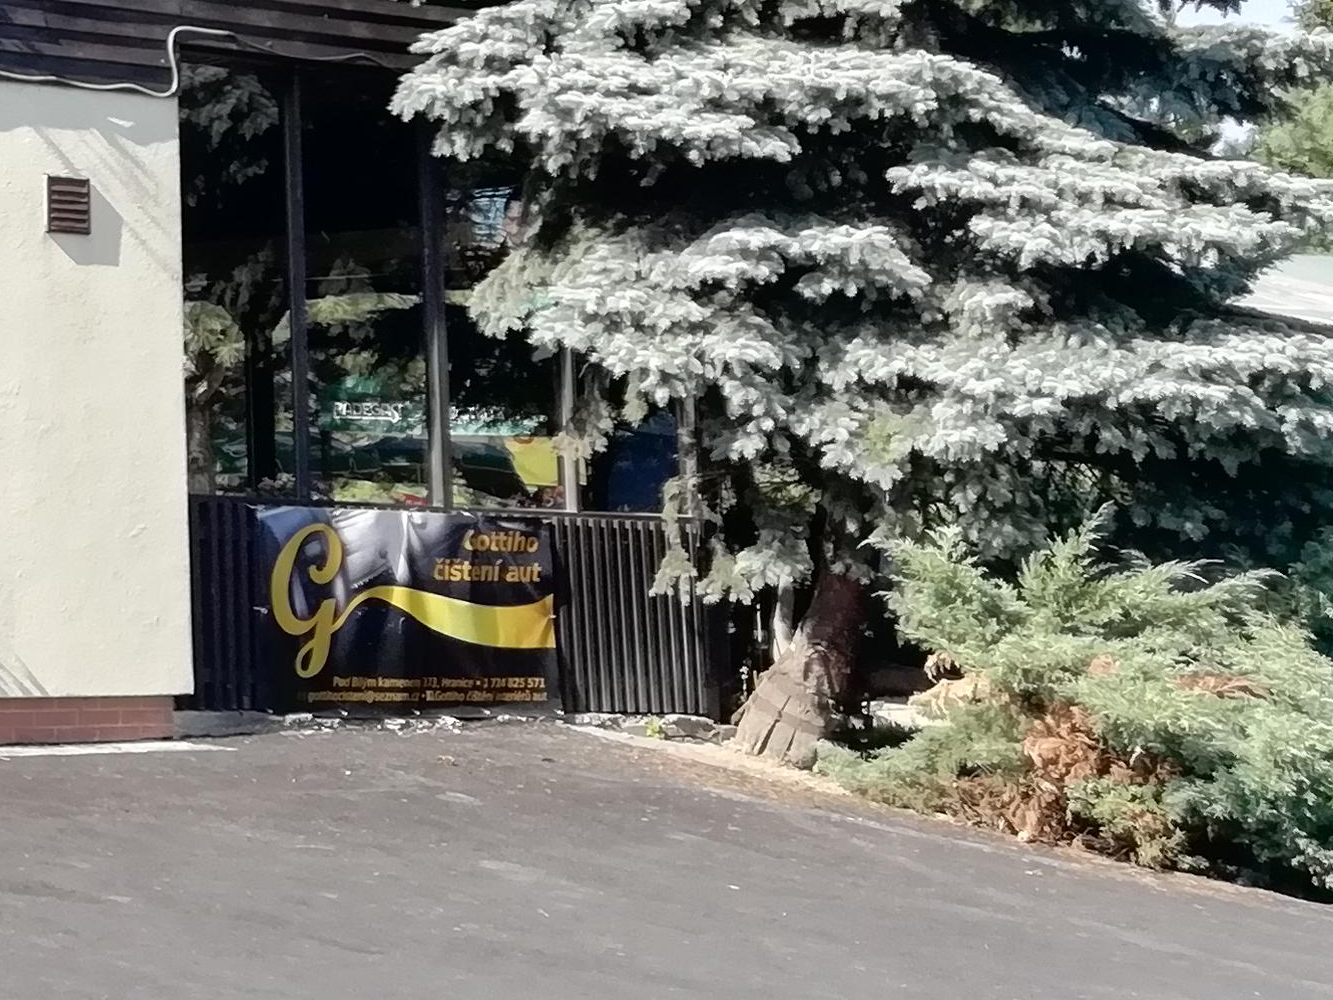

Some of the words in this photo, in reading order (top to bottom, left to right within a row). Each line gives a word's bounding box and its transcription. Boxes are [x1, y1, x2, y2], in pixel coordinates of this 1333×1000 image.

[463, 529, 539, 553] Gottiho
[505, 562, 542, 583] aut
[527, 677, 545, 688] 571
